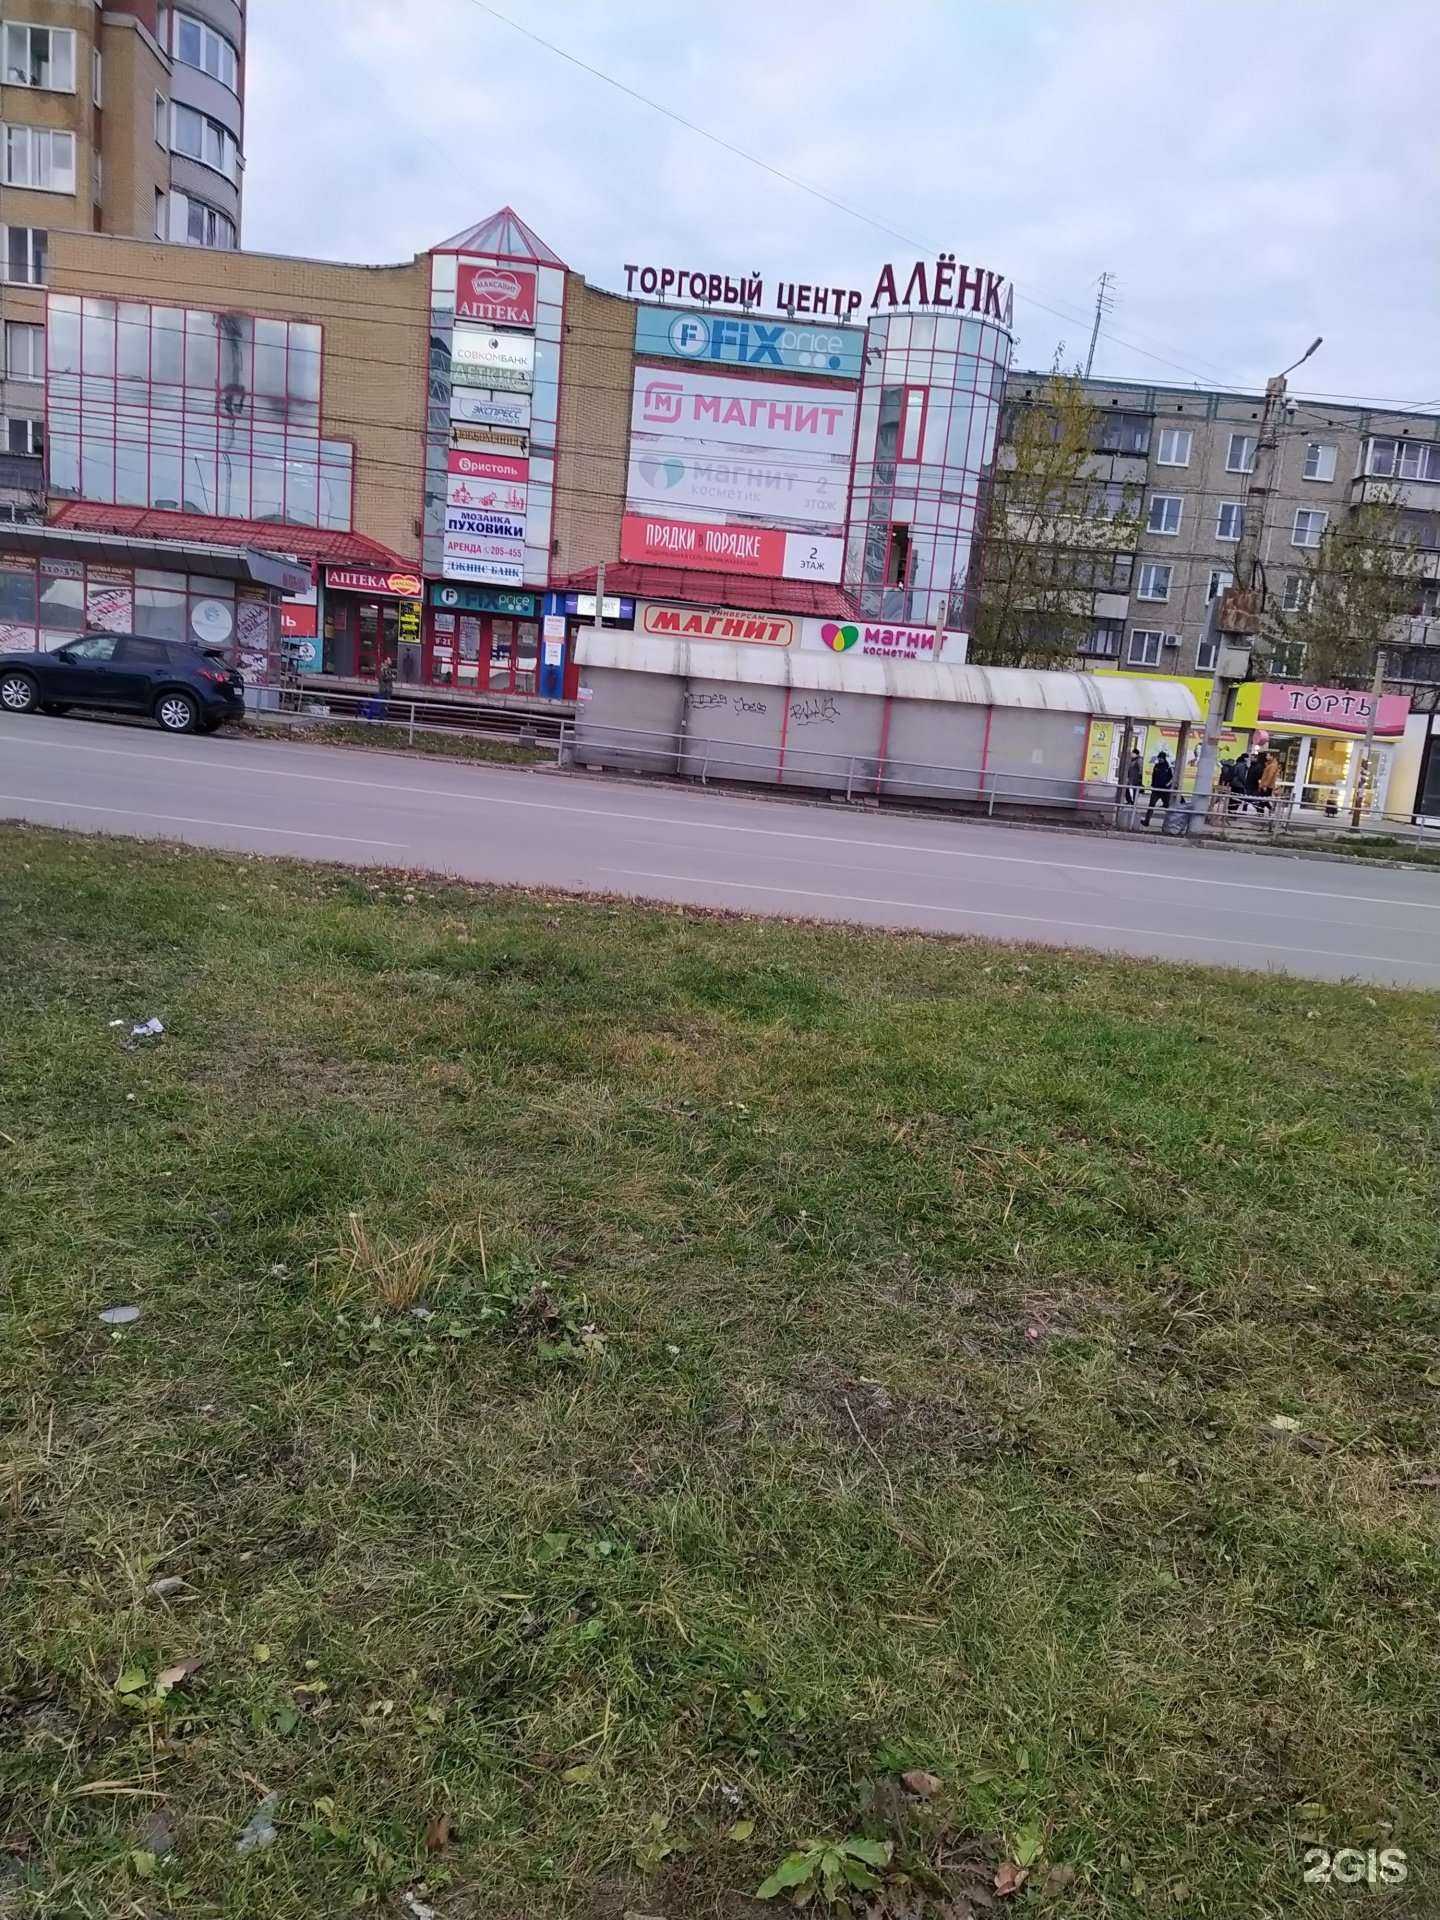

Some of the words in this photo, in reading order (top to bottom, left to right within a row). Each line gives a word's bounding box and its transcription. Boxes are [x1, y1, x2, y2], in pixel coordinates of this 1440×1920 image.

[623, 263, 763, 307] ТОРГОВЫЙ
[776, 281, 863, 316] ЦЕНТР
[458, 301, 531, 323] АПТЕКА
[457, 350, 529, 365] СОВКОМБАНК
[471, 405, 523, 418] ЭКСПРЕСС
[692, 394, 844, 436] МАГНИТ
[458, 457, 518, 476] Бристоль
[816, 476, 829, 494] 2
[461, 512, 511, 525] МОЗАИКА
[448, 519, 524, 538] ПУХОВИКИ
[448, 541, 482, 554] АРЕНДА
[646, 523, 696, 551] ПРЯДКИ
[705, 530, 761, 559] ПОРЯДКЕ
[809, 547, 819, 560] 2
[799, 559, 825, 571] ЭТАЖ
[329, 571, 387, 588] АПТЕКА
[651, 611, 786, 642] МАГНИТ
